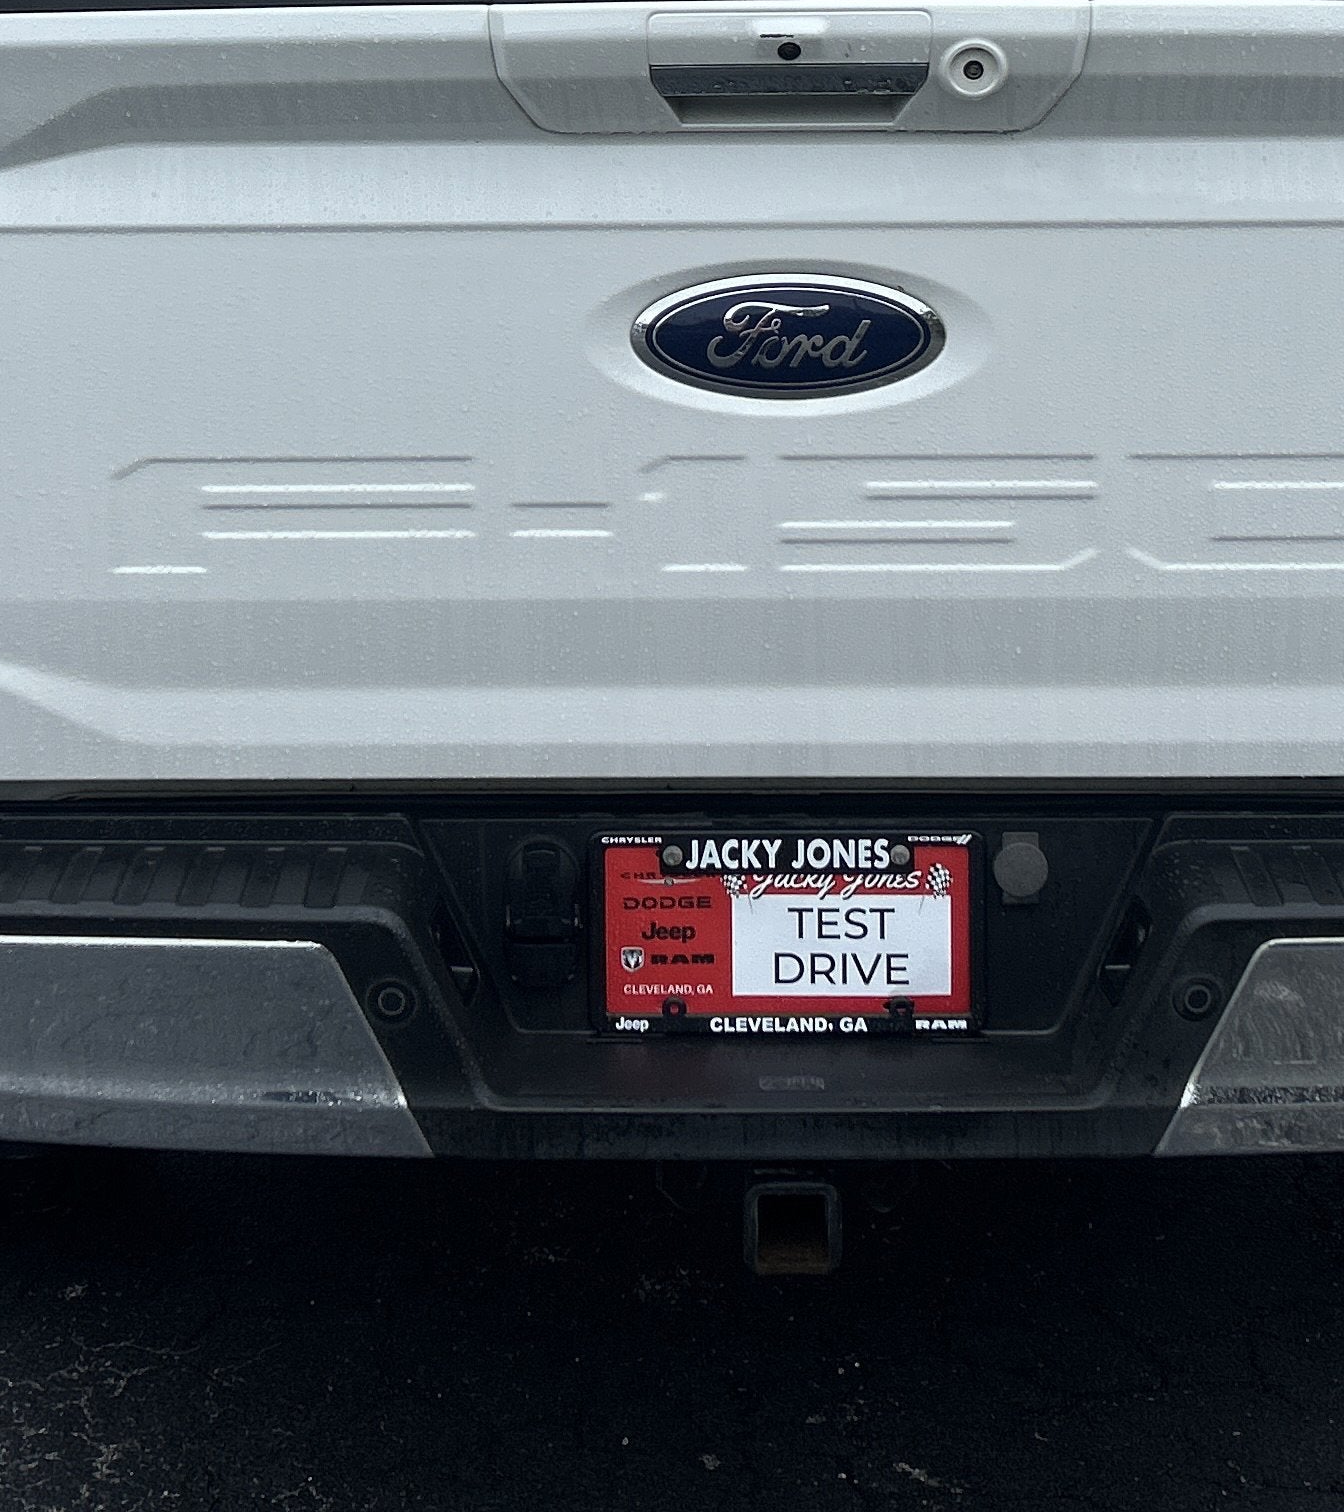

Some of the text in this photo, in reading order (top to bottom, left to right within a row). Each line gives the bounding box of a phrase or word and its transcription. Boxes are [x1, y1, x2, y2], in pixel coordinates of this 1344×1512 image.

[707, 301, 872, 368] Ford
[601, 836, 663, 845] CHRYSLER
[685, 837, 890, 870] JACKY JONES
[622, 896, 713, 910] DODGE
[641, 920, 696, 944] Jeep
[787, 907, 896, 940] TEST
[650, 953, 715, 965] RAM
[774, 952, 911, 986] DRIVE
[623, 983, 714, 996] CLEVELAND, GA
[615, 1016, 650, 1033] Jeep
[839, 1016, 868, 1033] GA
[914, 1019, 968, 1030] RAM
